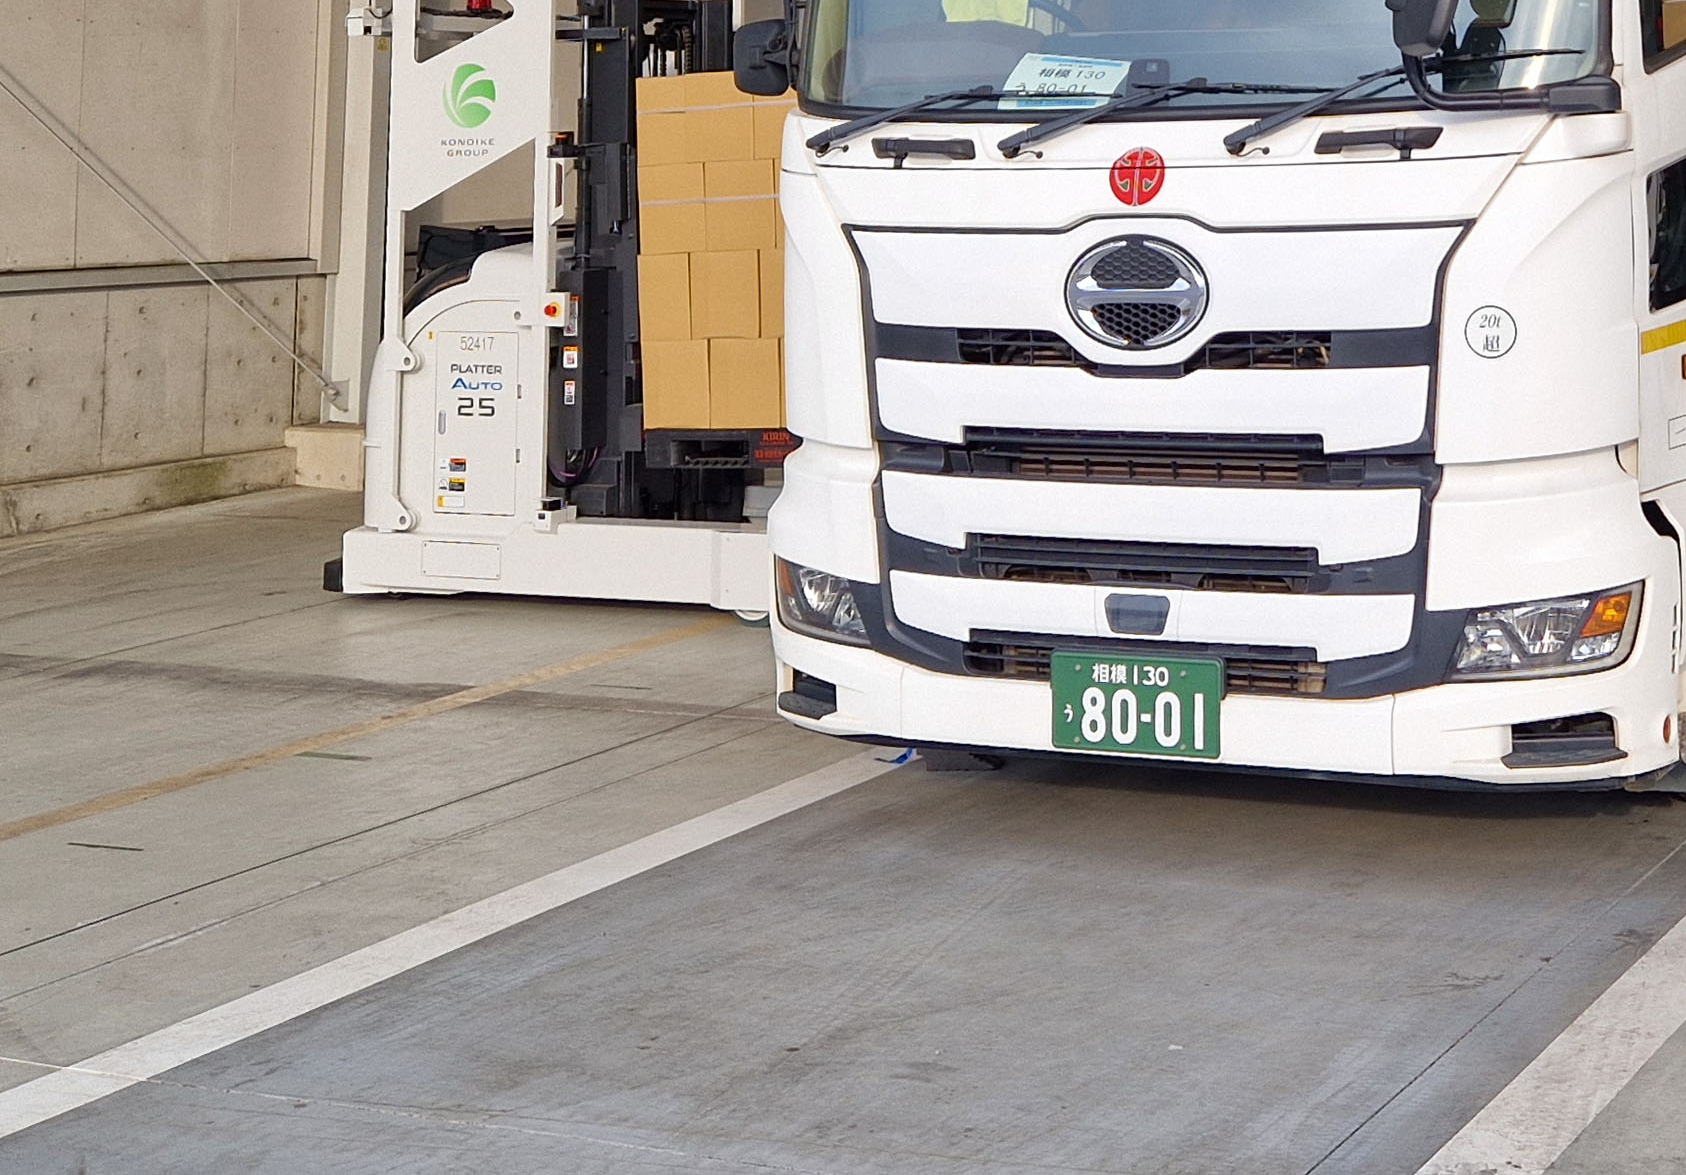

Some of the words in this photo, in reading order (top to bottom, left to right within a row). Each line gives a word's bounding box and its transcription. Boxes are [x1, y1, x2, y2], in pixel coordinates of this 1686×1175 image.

[1076, 69, 1106, 80] 130
[440, 137, 496, 146] KONOIKE
[446, 149, 489, 157] GROUP
[460, 336, 495, 351] 52417
[450, 364, 503, 375] PLATTER
[457, 397, 496, 417] 25
[1091, 663, 1128, 684] 相模
[1132, 664, 1170, 687] 130
[1063, 703, 1074, 723] う
[1081, 686, 1206, 751] 80-01
